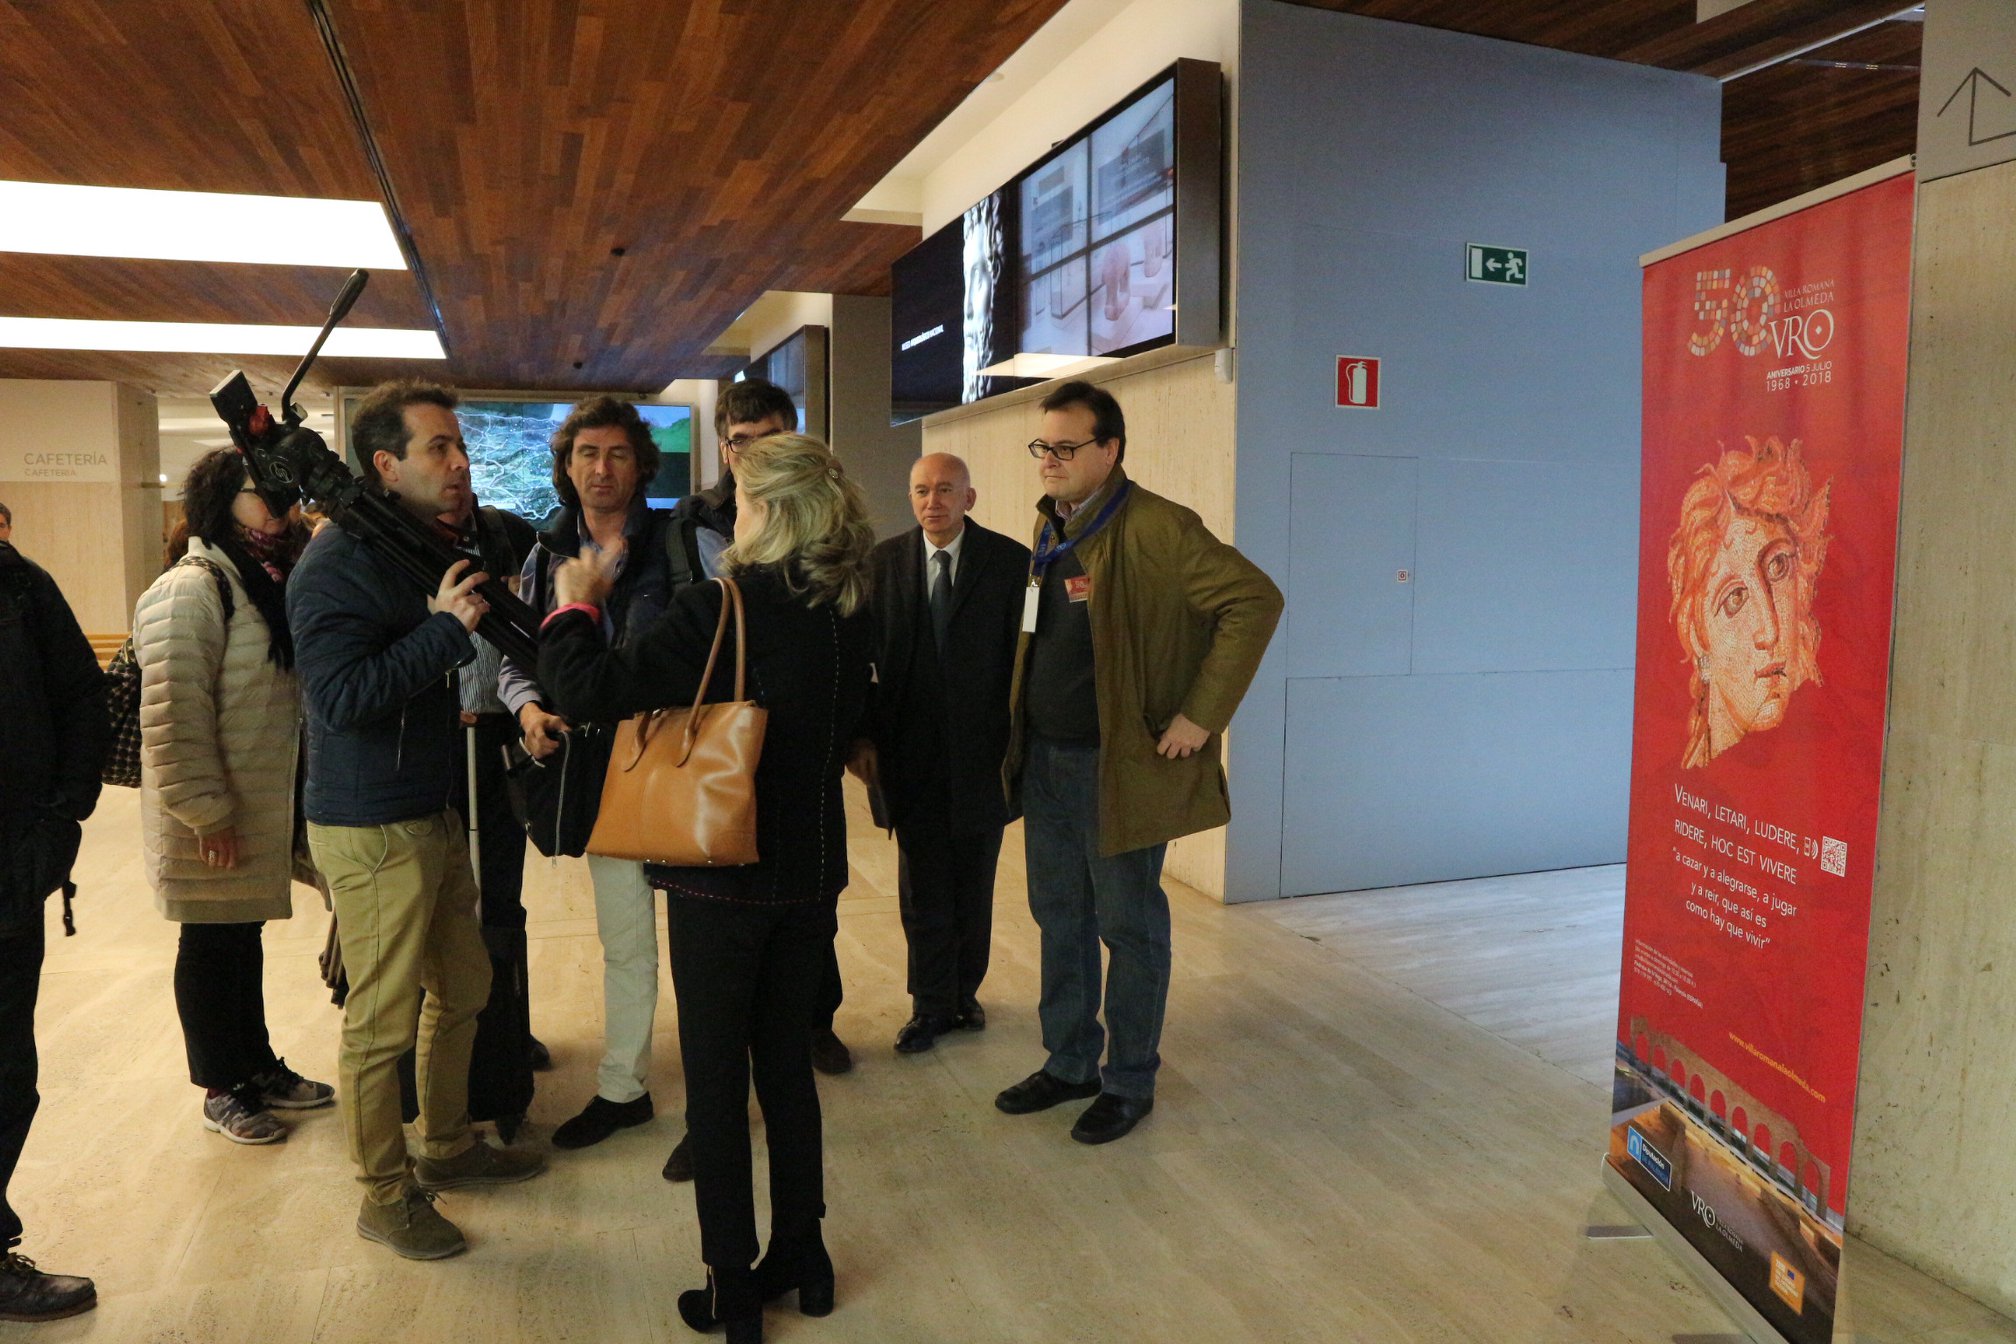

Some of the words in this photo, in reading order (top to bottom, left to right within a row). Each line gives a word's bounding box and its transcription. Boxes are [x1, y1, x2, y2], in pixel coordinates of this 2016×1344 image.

[1687, 266, 1780, 357] 50
[1783, 301, 1794, 313] LA
[1794, 291, 1834, 310] OLMEDA
[1768, 309, 1834, 360] VRO
[1766, 365, 1806, 380] ANIVERSARIO
[1811, 360, 1833, 373] JULIO
[1766, 377, 1791, 392] 1968
[1802, 371, 1832, 386] 2018
[24, 451, 108, 466] CAFETERÍA
[1715, 804, 1750, 835] LETARI,
[1754, 819, 1800, 855] LUDERE,
[1674, 818, 1707, 849] RIDERE,
[1711, 836, 1734, 858] HOC
[1737, 846, 1756, 866] EST
[1759, 856, 1797, 885] VIVERE
[1682, 854, 1702, 872] cazar
[1717, 869, 1760, 903] alegrarse,
[1763, 892, 1769, 904] a
[1771, 893, 1797, 917] jugar
[1685, 899, 1709, 920] como
[1710, 909, 1725, 932] hay
[1726, 919, 1744, 939] que
[1722, 897, 1739, 914] que
[1740, 903, 1754, 922] así
[1755, 914, 1767, 928] es
[1691, 1190, 1716, 1228] VRO
